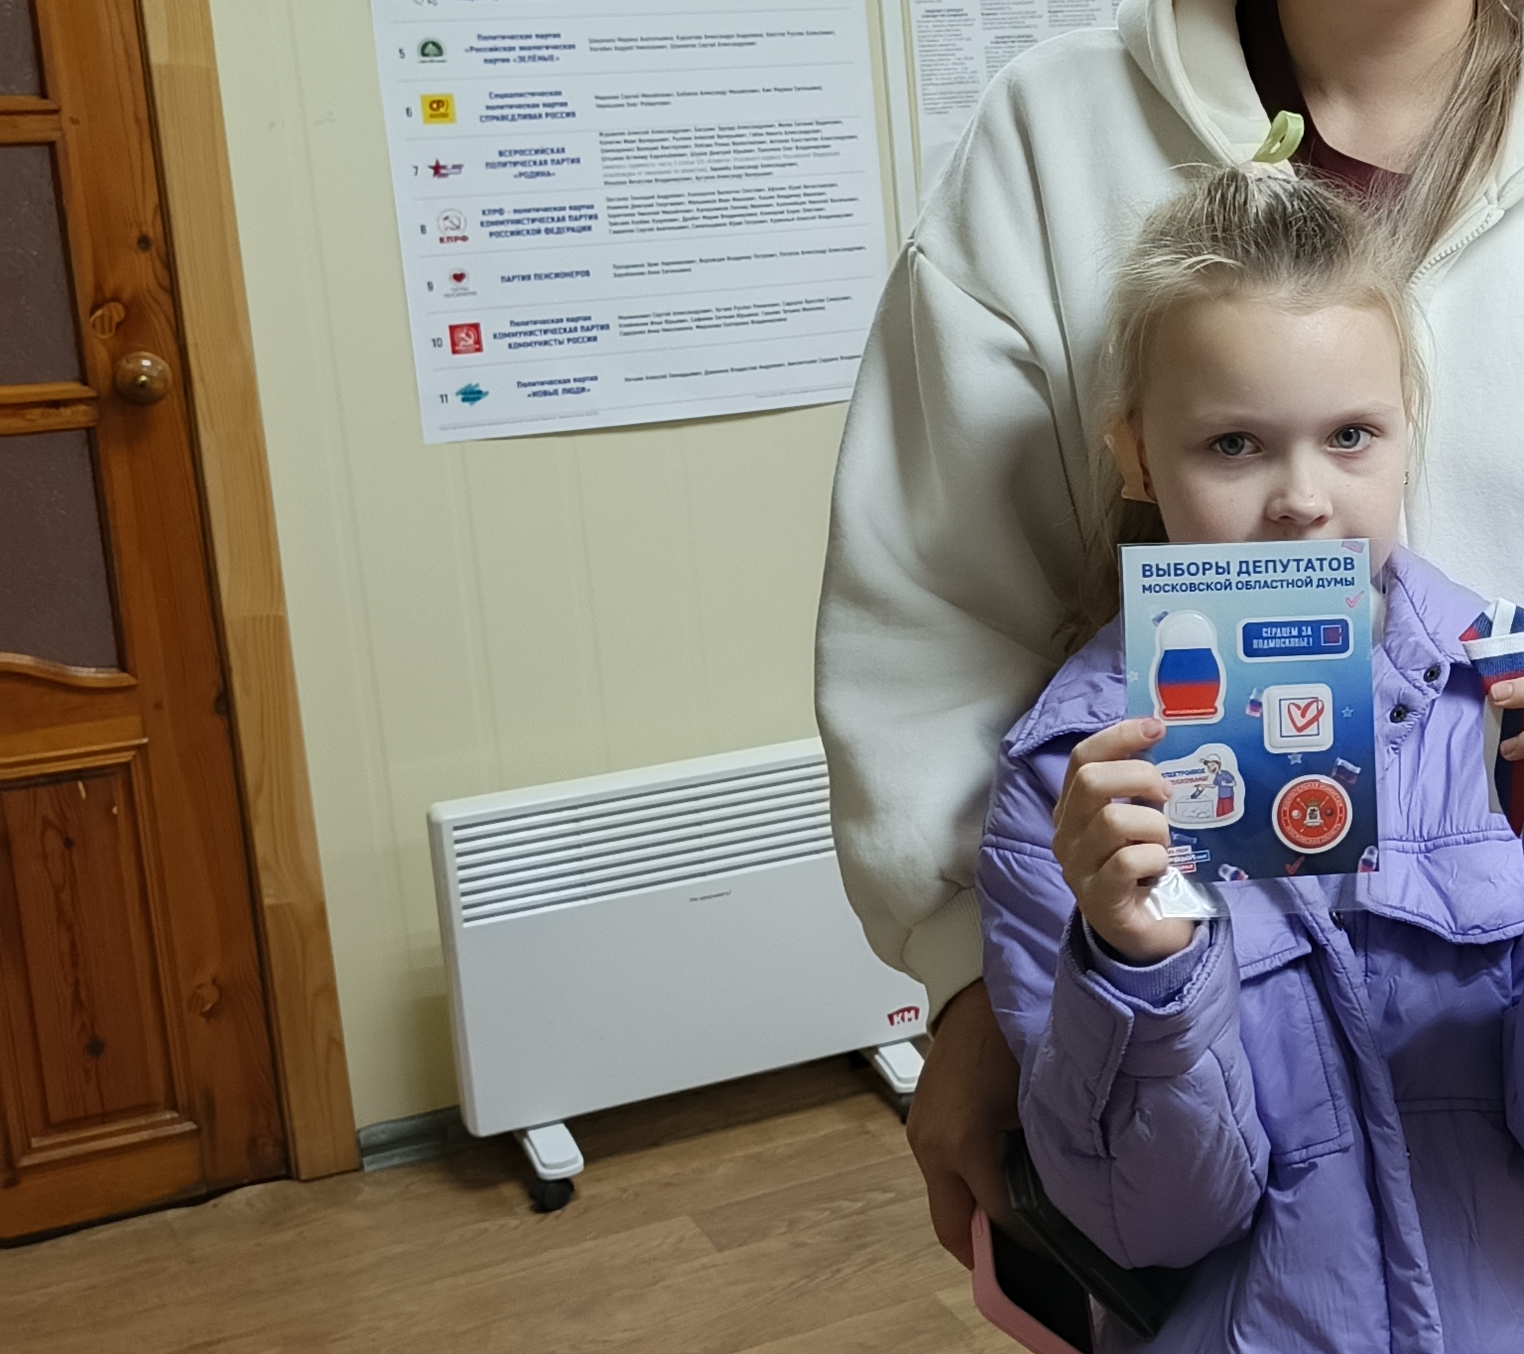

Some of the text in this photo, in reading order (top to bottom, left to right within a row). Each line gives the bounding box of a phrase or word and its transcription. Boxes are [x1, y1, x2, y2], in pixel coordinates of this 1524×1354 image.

[1141, 557, 1355, 578] ВЫБОРЫ ДЕПУТАТОВ
[1142, 576, 1355, 594] МОСКОВСКОЙ ОБЛАСТНОЙ ДУМЫ
[1301, 625, 1312, 636] ЗА
